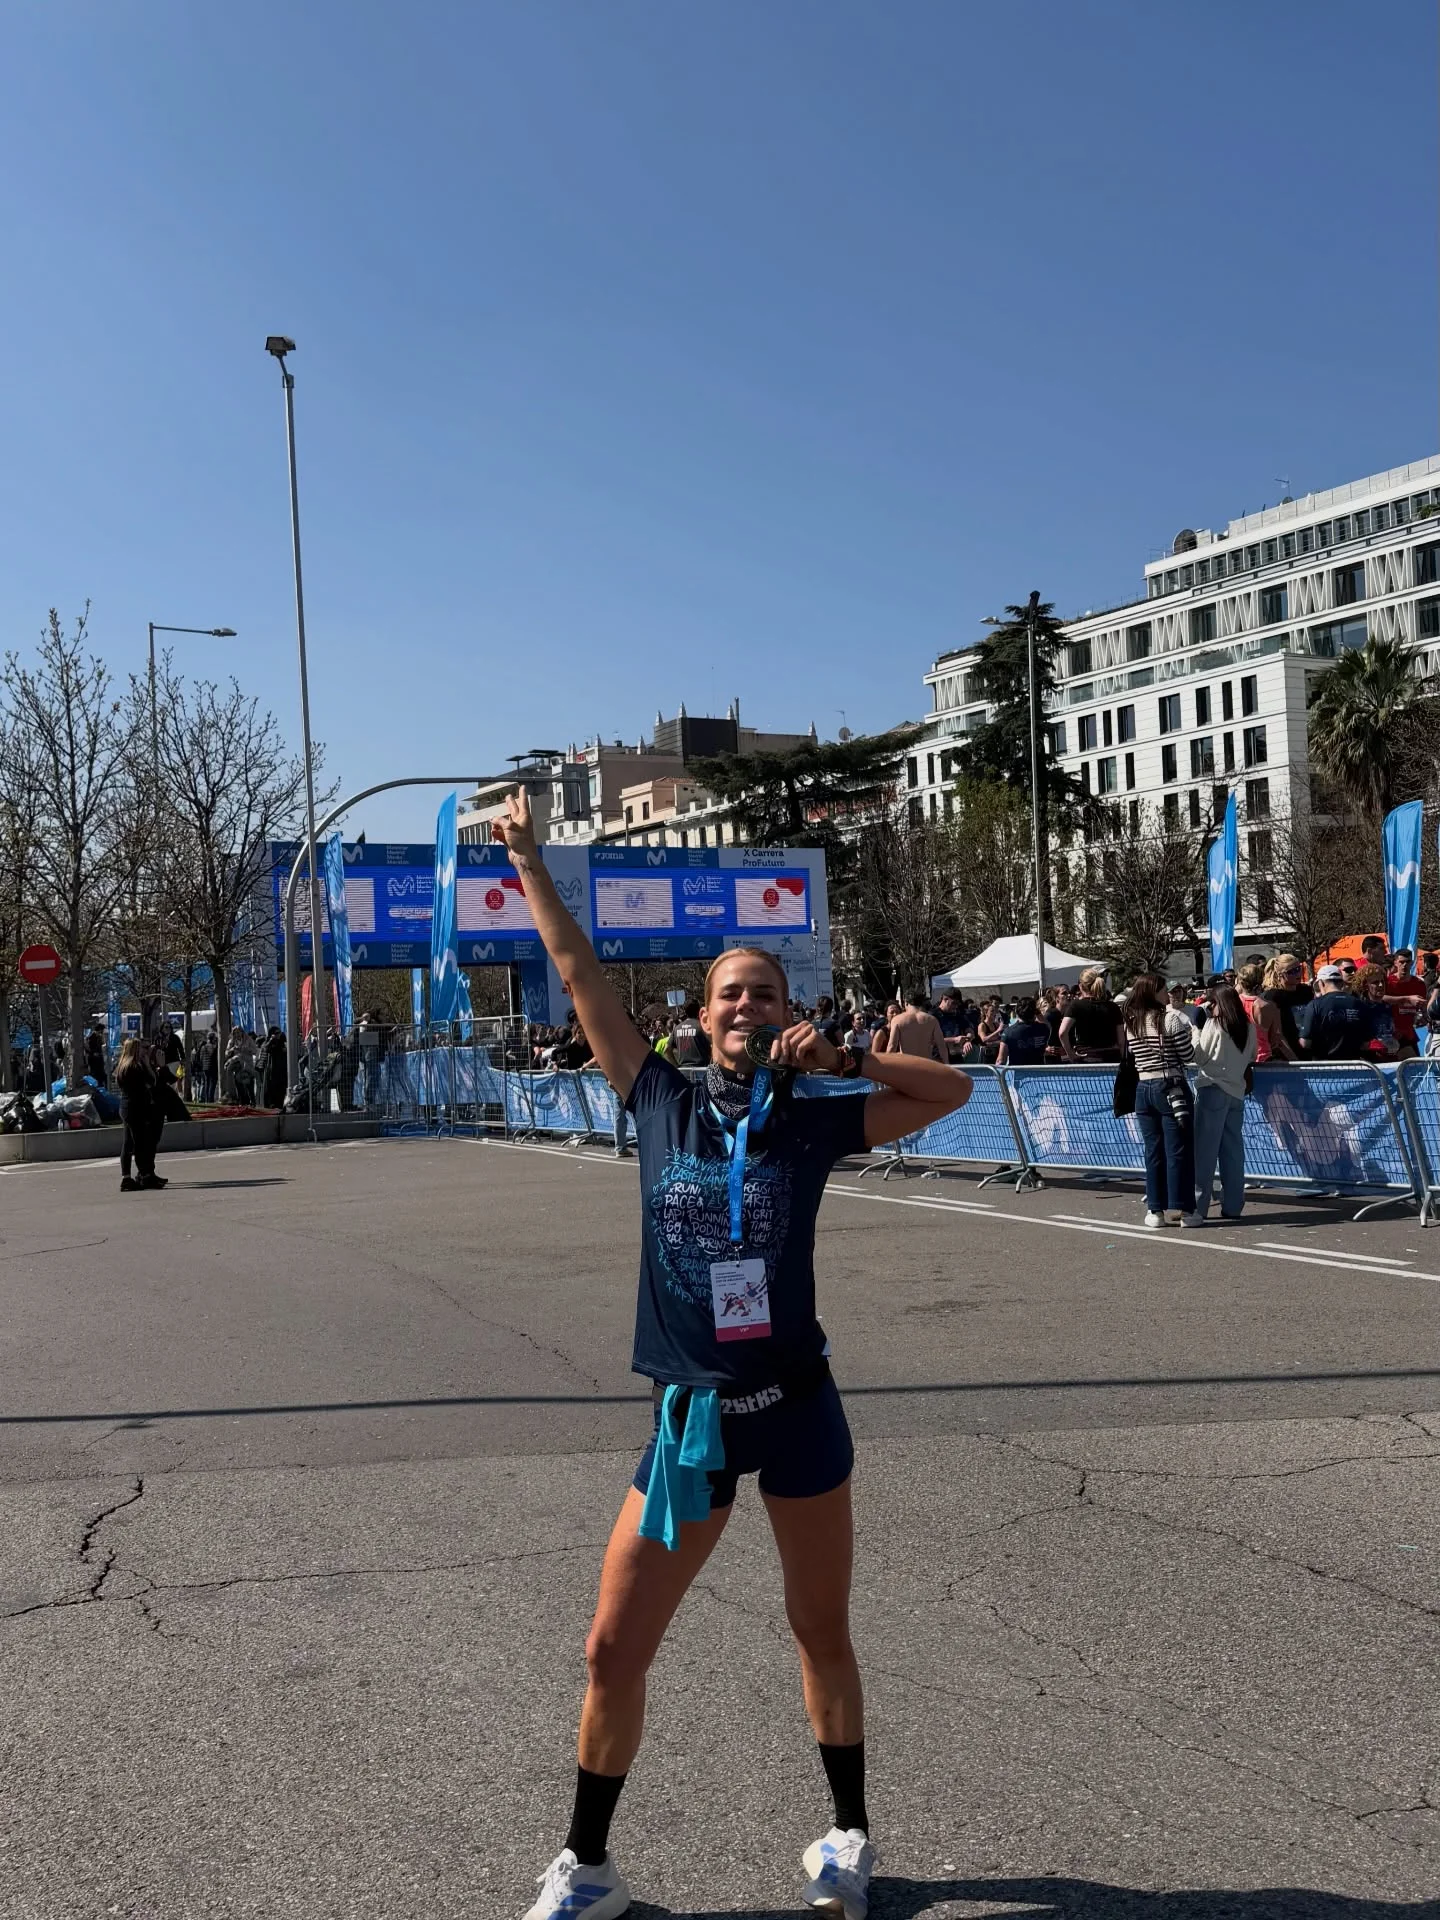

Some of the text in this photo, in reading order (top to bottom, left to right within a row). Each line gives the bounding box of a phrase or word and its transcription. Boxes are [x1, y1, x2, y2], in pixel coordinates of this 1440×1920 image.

[744, 849, 784, 857] X Carrera
[743, 859, 785, 867] ProFuturo
[754, 1075, 767, 1103] 2026
